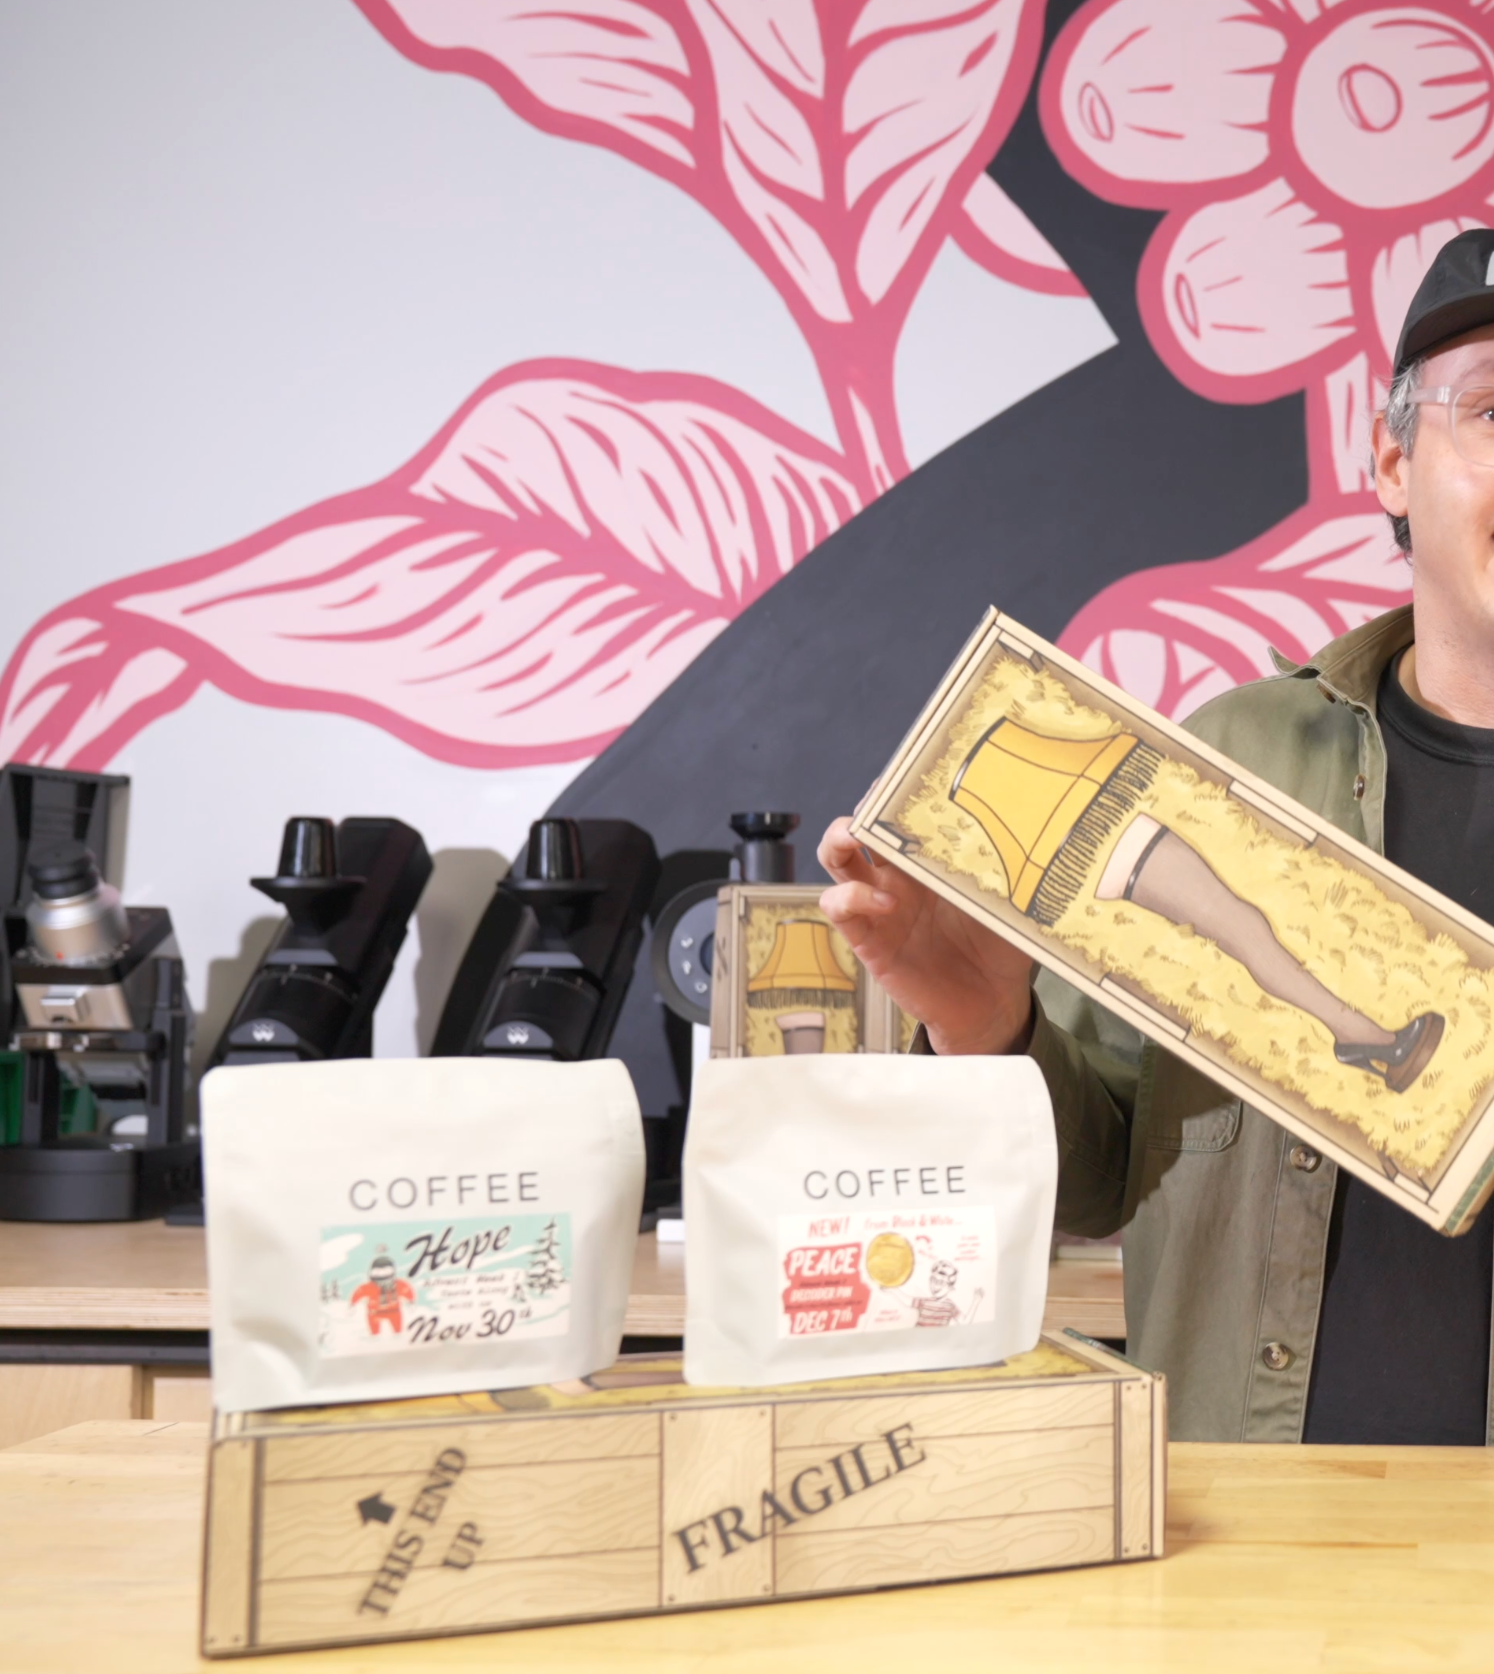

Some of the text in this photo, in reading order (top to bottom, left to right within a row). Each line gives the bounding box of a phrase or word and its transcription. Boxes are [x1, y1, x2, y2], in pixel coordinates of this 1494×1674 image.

[349, 1172, 540, 1211] COFFEE
[803, 1166, 966, 1200] COFFEE
[808, 1215, 850, 1238] NEW!
[404, 1225, 511, 1278] Hope
[788, 1247, 859, 1278] PEACE
[407, 1315, 472, 1344] Nov
[793, 1310, 828, 1334] DEC
[672, 1421, 928, 1575] FRAGILE
[356, 1448, 467, 1617] THIS END
[442, 1521, 484, 1571] UP
